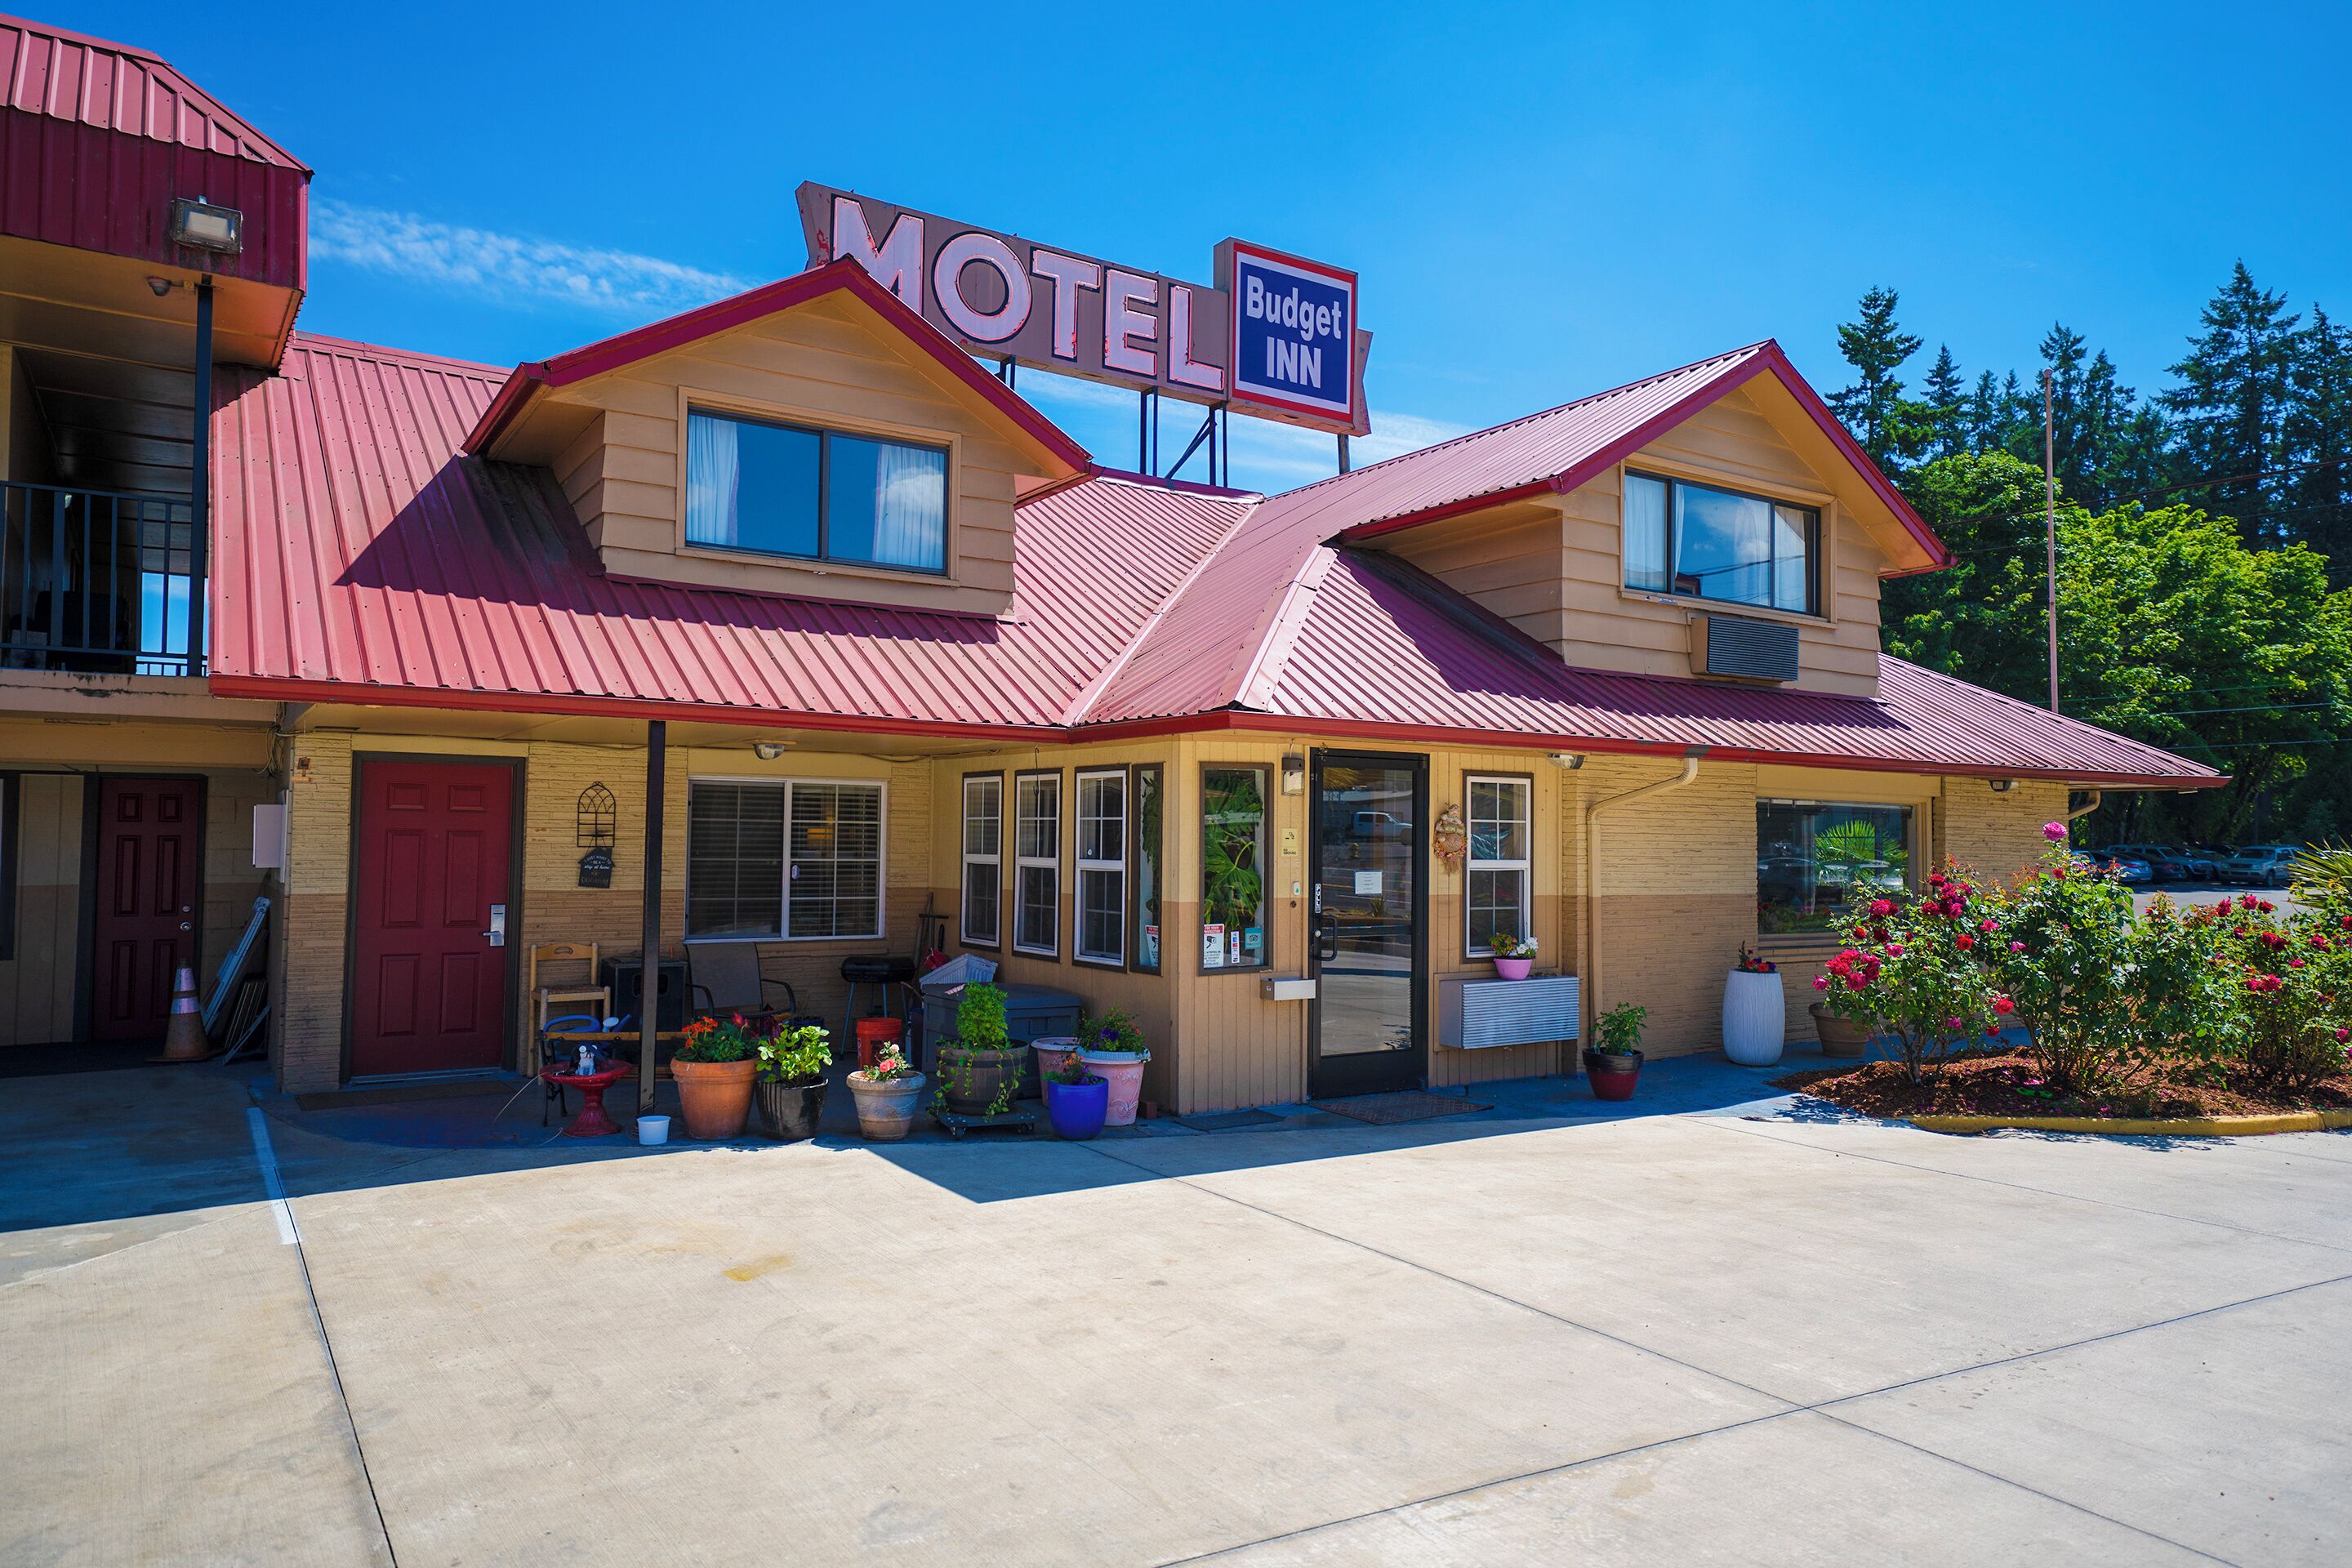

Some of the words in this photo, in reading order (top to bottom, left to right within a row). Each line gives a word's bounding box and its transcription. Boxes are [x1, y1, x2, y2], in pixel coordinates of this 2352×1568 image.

[833, 194, 1225, 391] MOTEL
[1246, 274, 1342, 341] Budget
[1267, 336, 1321, 389] INN
